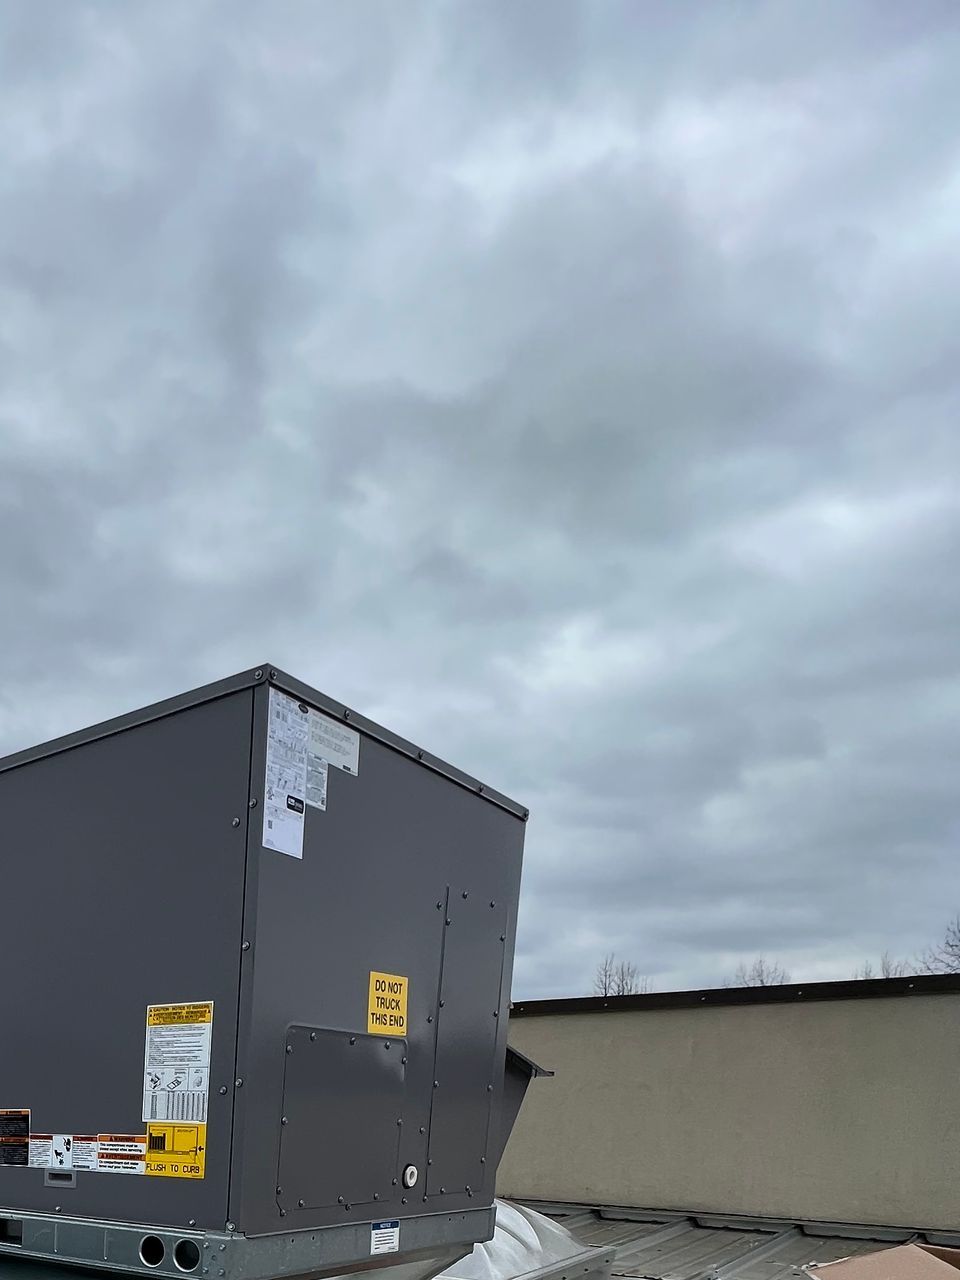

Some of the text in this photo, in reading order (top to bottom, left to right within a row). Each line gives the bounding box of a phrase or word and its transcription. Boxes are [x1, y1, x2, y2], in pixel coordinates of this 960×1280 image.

[375, 980, 403, 995] DO NOT
[376, 996, 401, 1011] TRUCK
[371, 1012, 404, 1027] THIS END
[146, 1162, 166, 1172] FLUSH
[171, 1164, 179, 1173] TO
[182, 1165, 200, 1174] CURB
